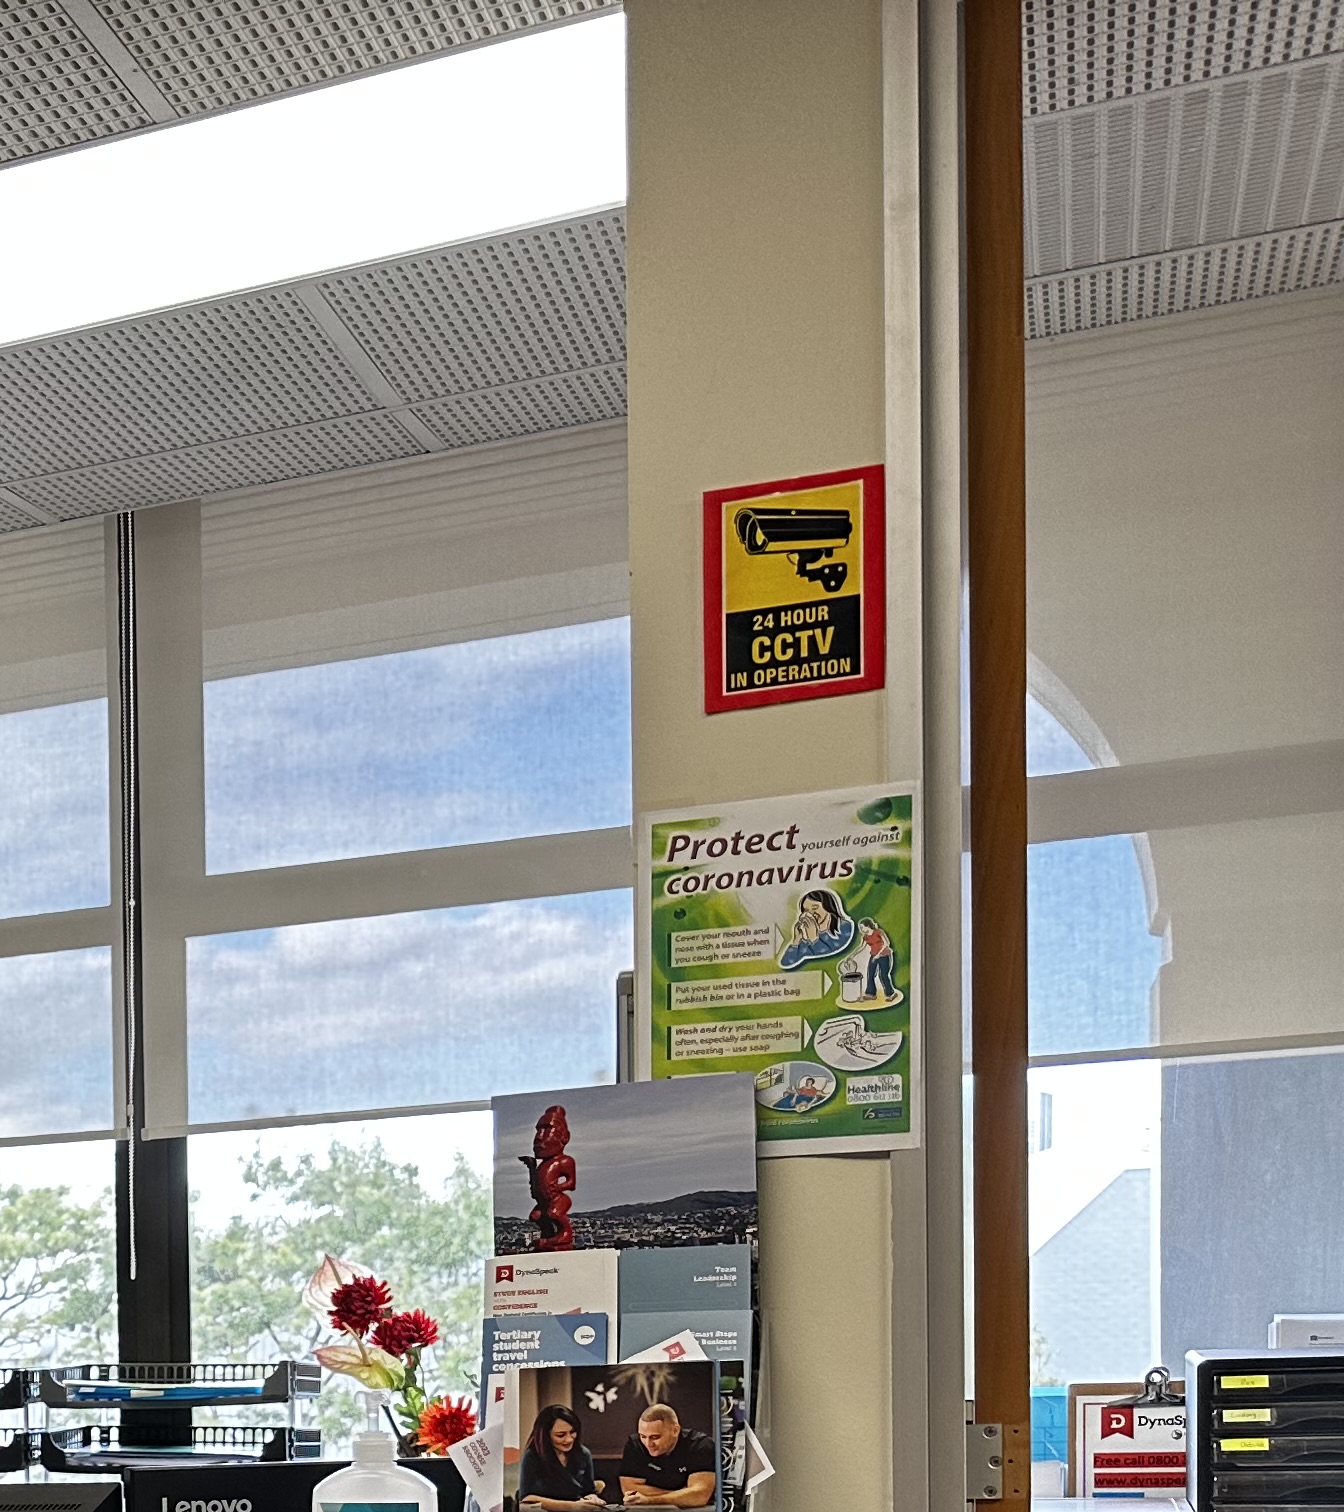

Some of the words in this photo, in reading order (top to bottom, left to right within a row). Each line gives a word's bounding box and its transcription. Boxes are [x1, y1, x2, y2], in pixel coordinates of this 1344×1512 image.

[752, 614, 774, 631] 24
[781, 605, 829, 627] HOUR
[752, 626, 835, 664] CCTV
[730, 671, 748, 688] IN
[753, 657, 852, 685] OPERATION
[666, 823, 801, 863] Protect
[800, 834, 852, 853] yourself
[852, 829, 901, 847] against
[666, 857, 855, 895] coronavirus
[675, 934, 699, 942] Cover
[702, 932, 720, 940] your
[753, 927, 769, 935] and
[747, 939, 769, 947] when
[692, 954, 718, 962] cough
[675, 986, 689, 994] Put
[692, 985, 711, 995] your
[713, 982, 732, 990] used
[735, 980, 760, 988] tissue
[772, 978, 786, 986] the
[737, 991, 744, 999] in
[754, 989, 781, 1000] plastic
[783, 988, 800, 997] bag
[675, 1027, 698, 1036] Wash
[719, 1025, 733, 1033] dry
[735, 1023, 754, 1032] your
[757, 1021, 783, 1029] hands
[847, 1083, 900, 1095] Healthline
[515, 1268, 559, 1277] DynaSpeak
[493, 1330, 541, 1340] Tertiary
[492, 1340, 540, 1351] student
[492, 1350, 527, 1361] travel
[1094, 1456, 1121, 1465] Free
[1124, 1455, 1146, 1465] call
[1148, 1456, 1179, 1465] 0800
